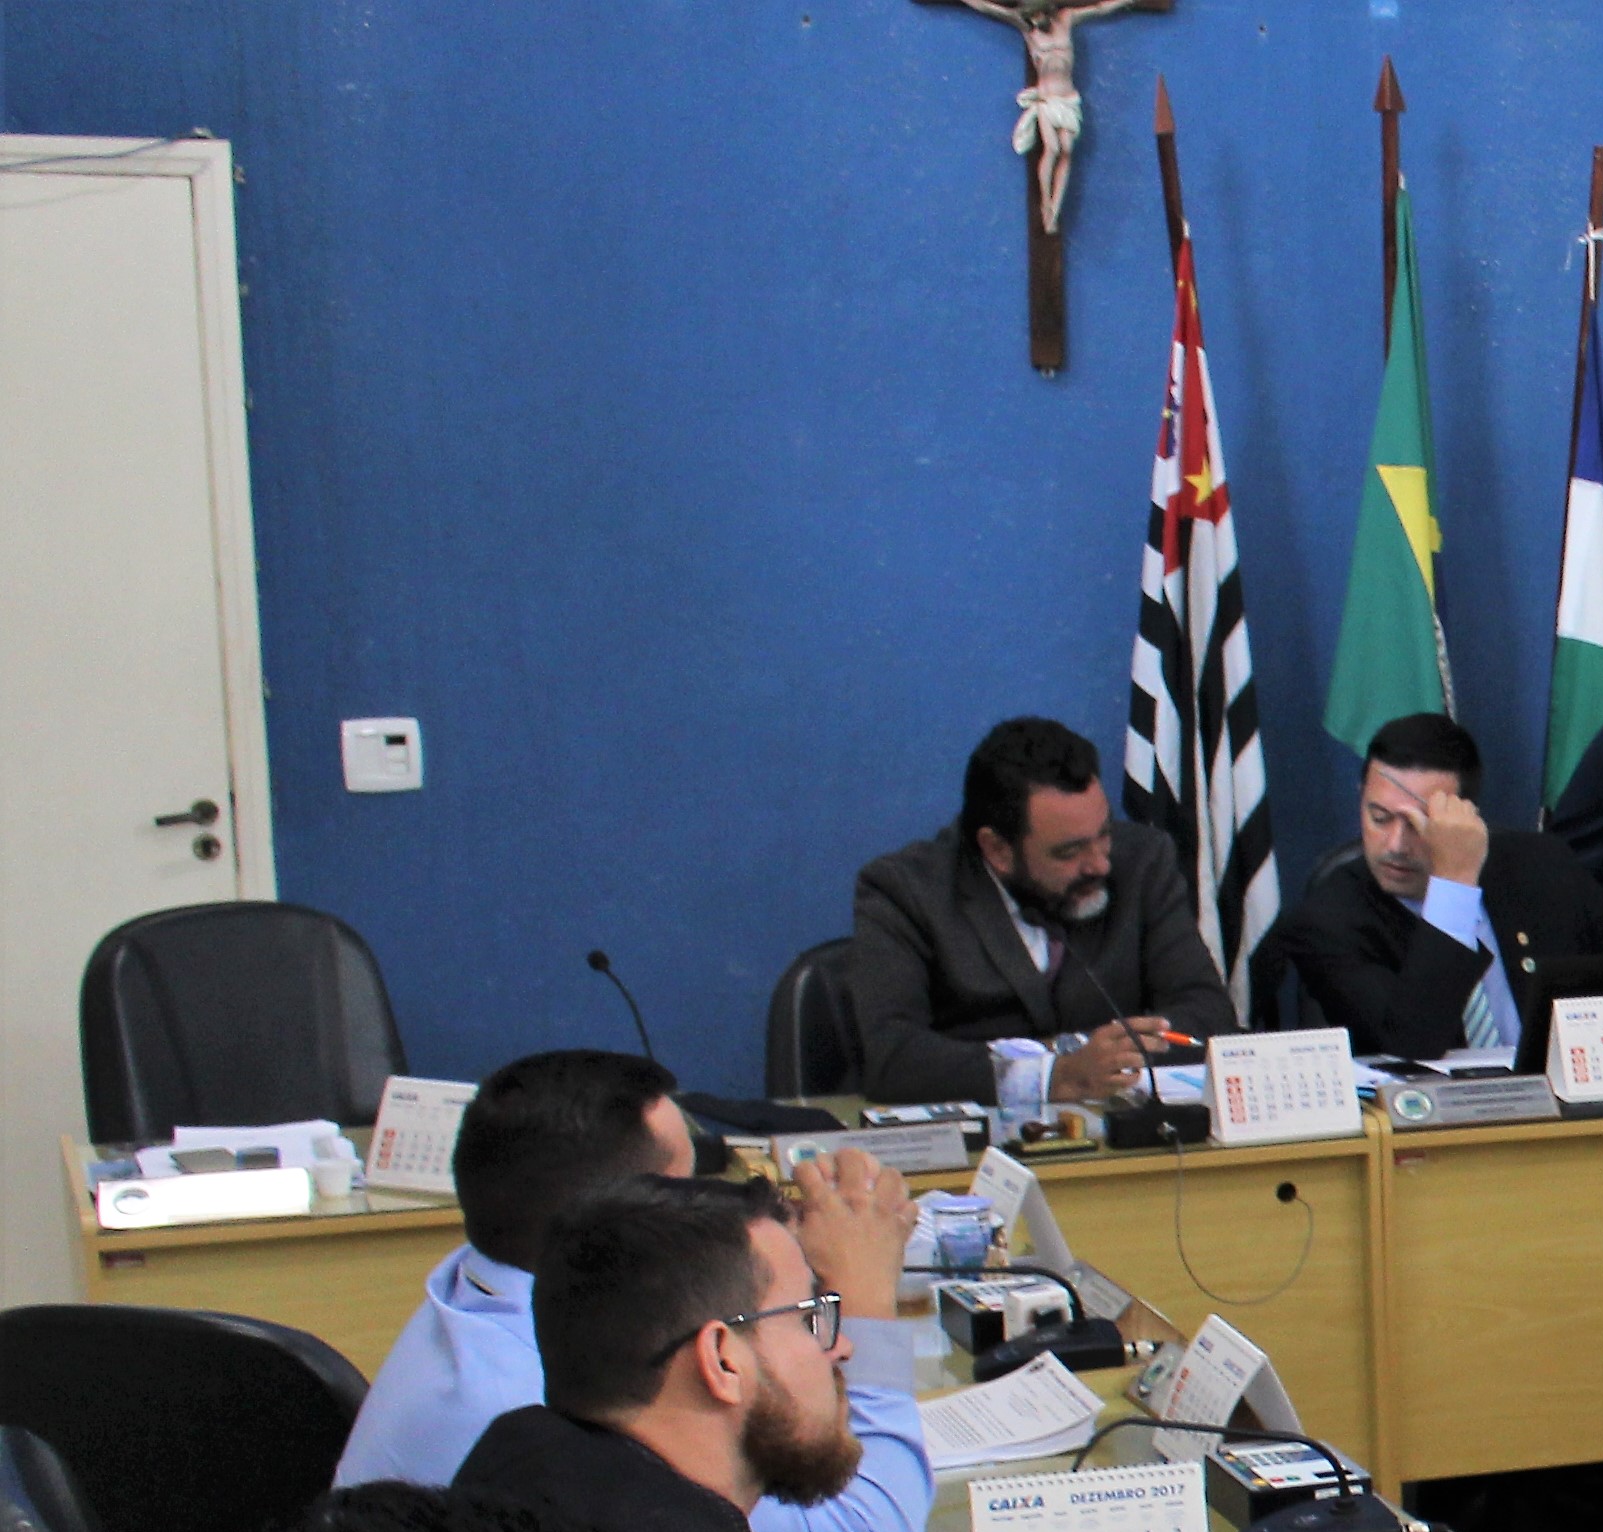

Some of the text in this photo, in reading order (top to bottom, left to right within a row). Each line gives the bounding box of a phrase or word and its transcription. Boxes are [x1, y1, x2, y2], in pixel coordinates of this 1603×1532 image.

[989, 1494, 1045, 1512] CAIXA
[1070, 1484, 1185, 1504] DEZEMBRO 2017
